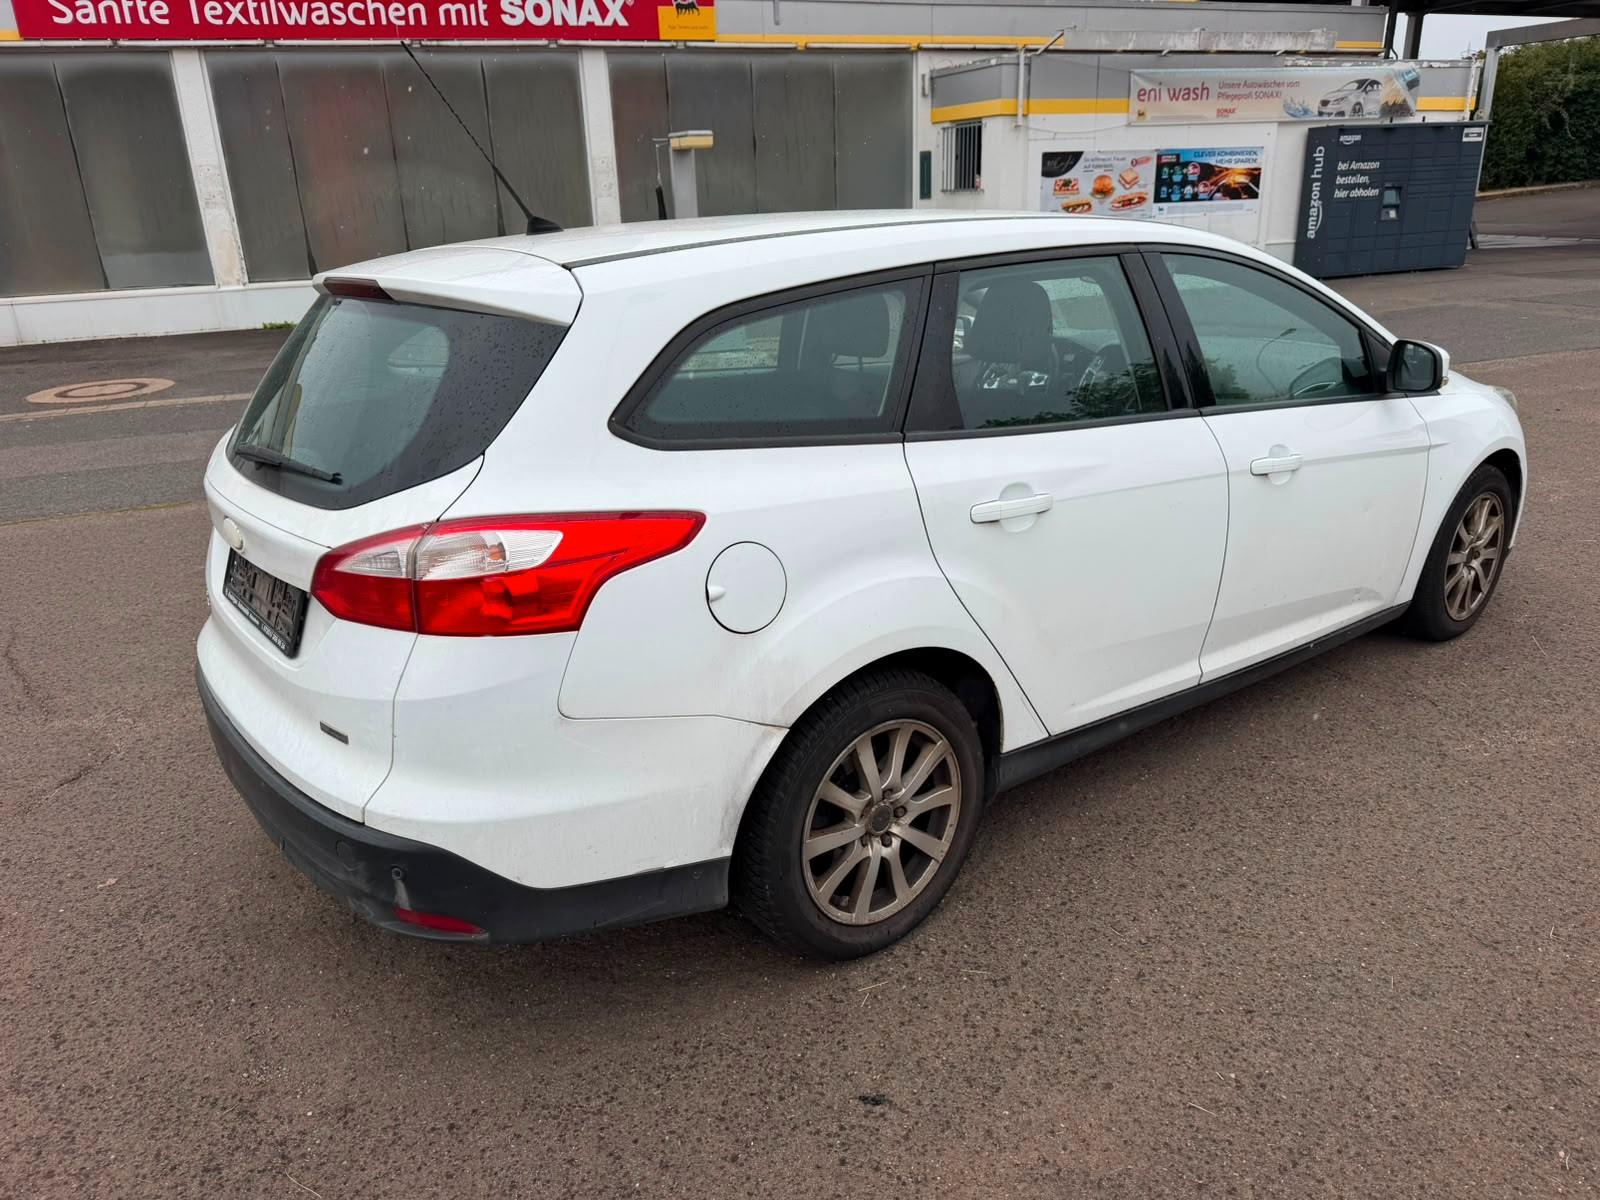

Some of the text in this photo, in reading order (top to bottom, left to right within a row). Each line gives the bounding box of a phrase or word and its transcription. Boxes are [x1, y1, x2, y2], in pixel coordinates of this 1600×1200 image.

[48, 0, 169, 25] Sanfte
[438, 0, 489, 27] mit
[500, 0, 629, 27] SONAX
[1218, 80, 1242, 90] Unsere
[1286, 80, 1301, 88] vom
[1137, 81, 1210, 102] eni wash
[1339, 134, 1362, 144] amazon
[1337, 161, 1380, 170] bei Amazon
[1307, 146, 1325, 239] amazon hub
[1334, 187, 1379, 198] hier abholen
